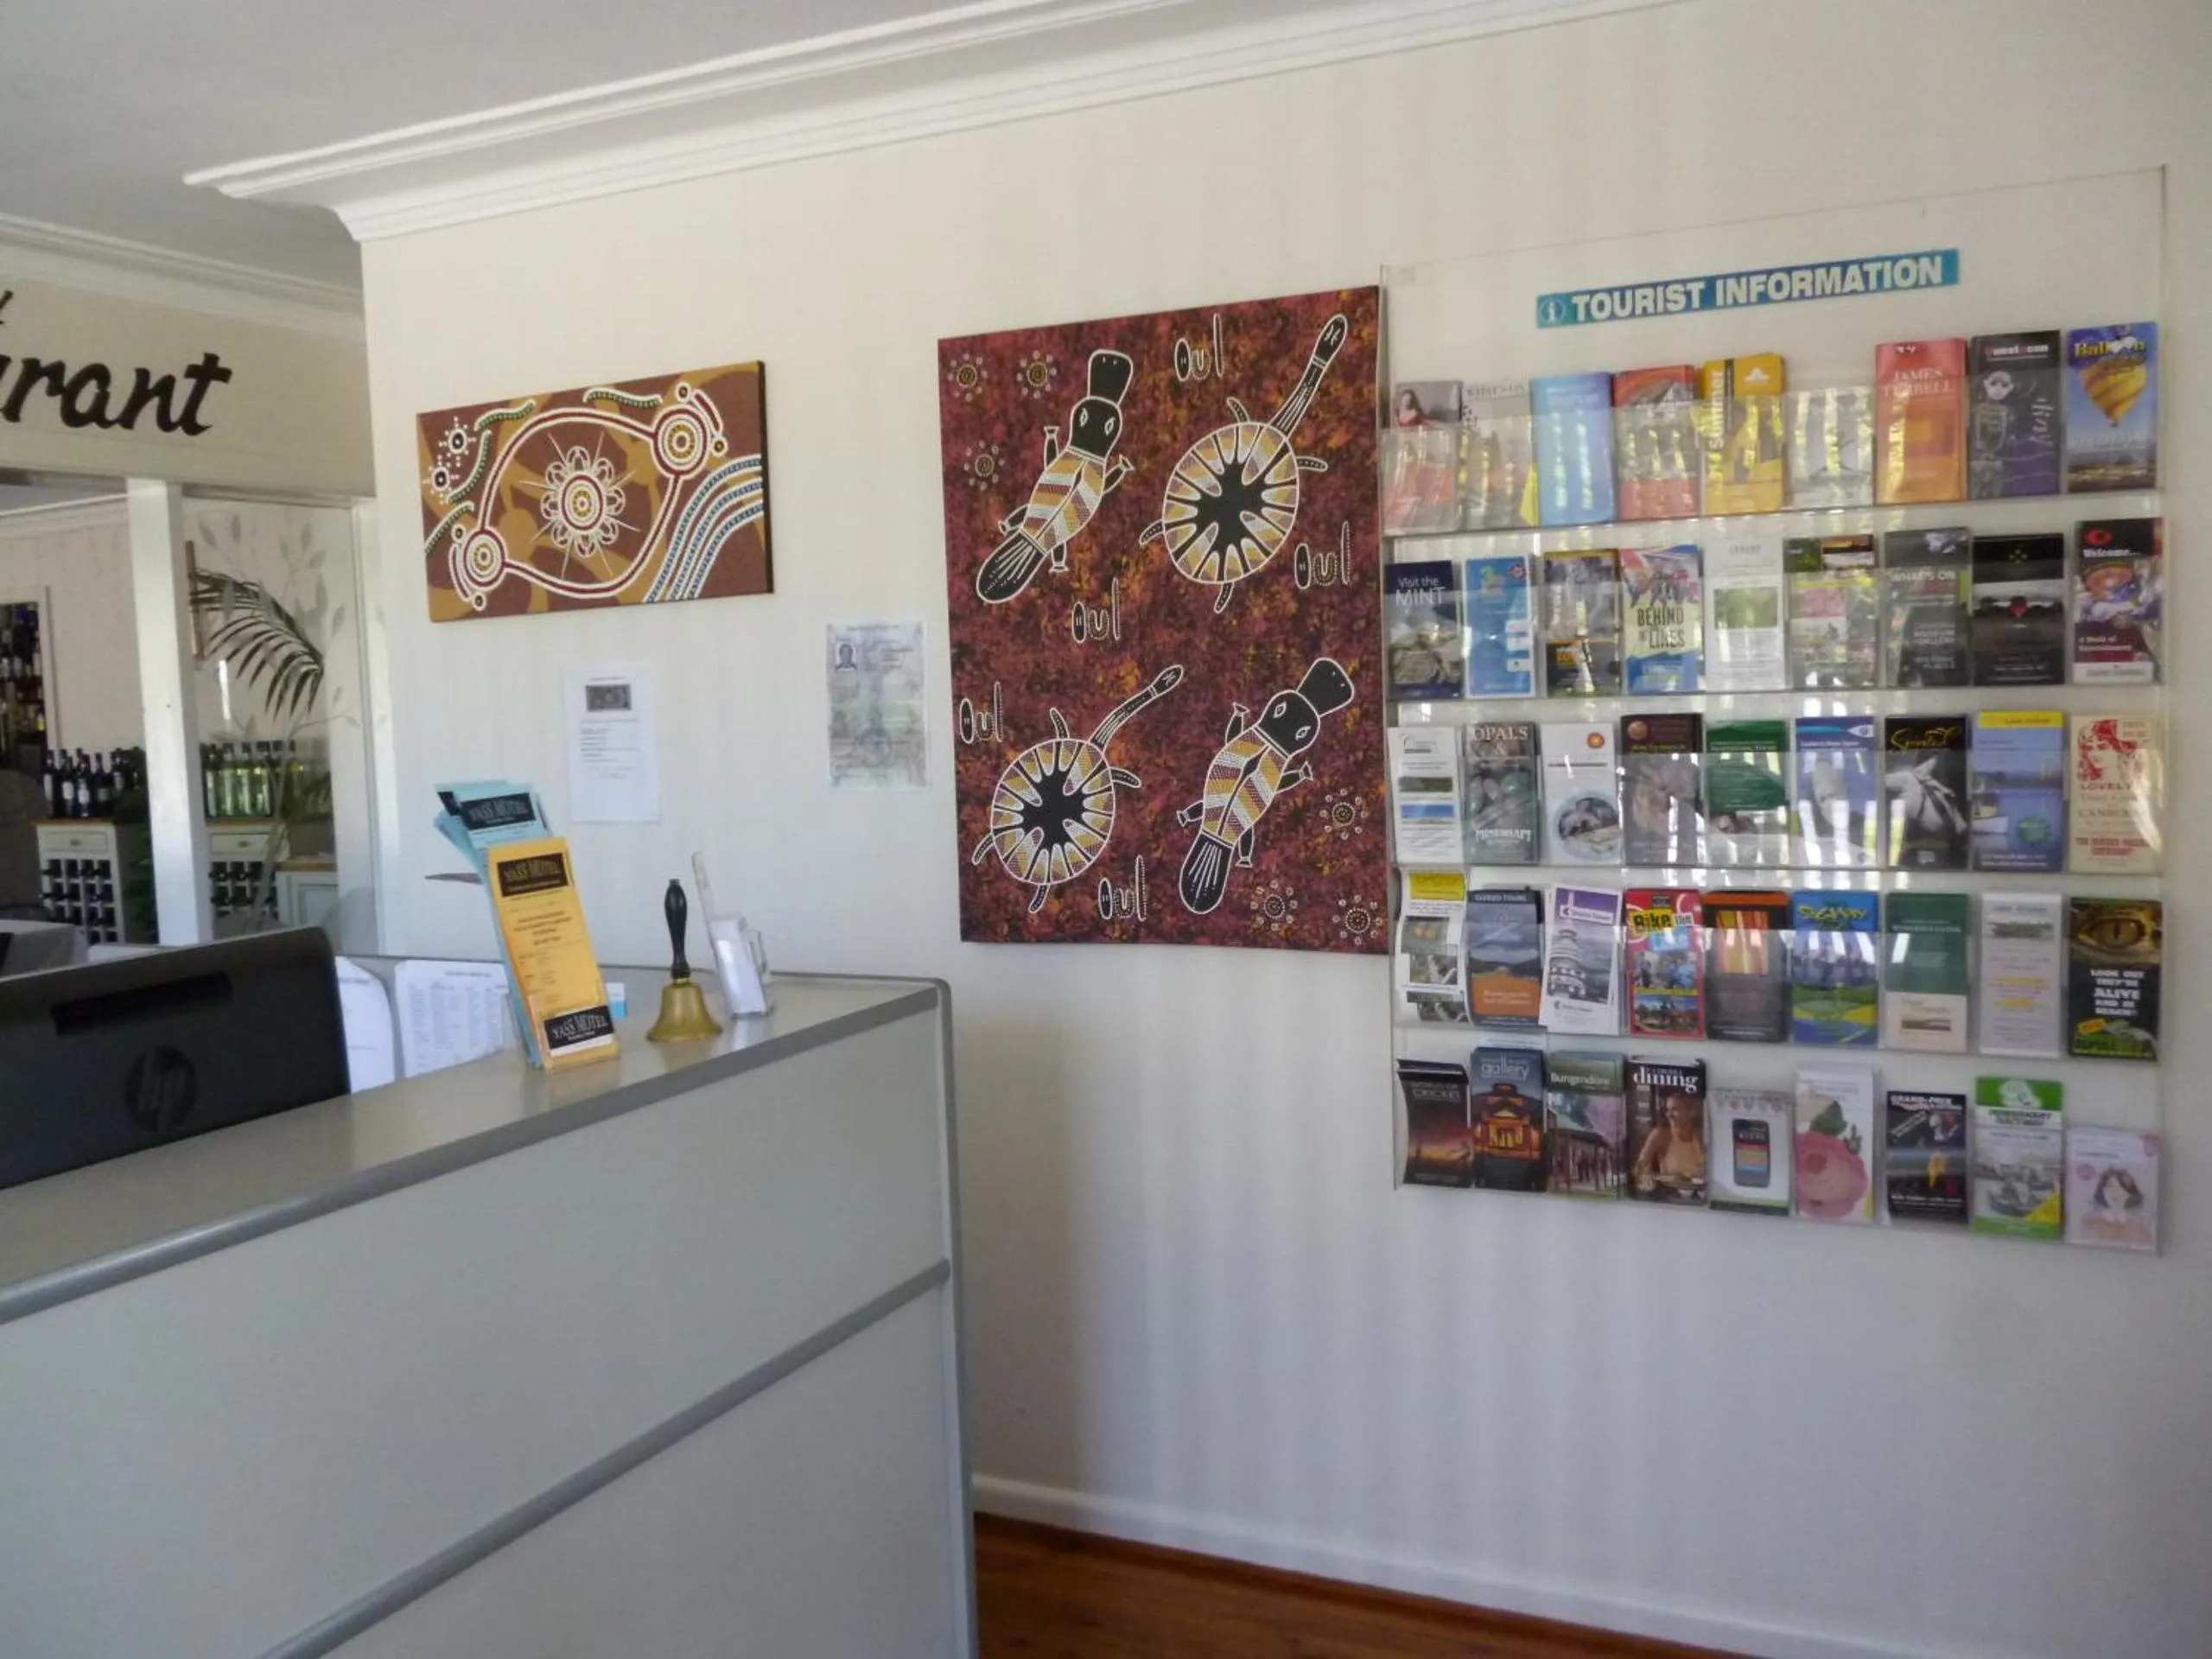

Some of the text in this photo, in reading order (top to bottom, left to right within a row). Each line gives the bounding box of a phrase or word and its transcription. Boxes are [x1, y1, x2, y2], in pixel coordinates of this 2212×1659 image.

[1572, 281, 1705, 321] TOURIST
[1715, 256, 1942, 307] INFORMATION
[1397, 575, 1440, 588] Visit the
[1395, 586, 1446, 606] MINT
[1637, 607, 1685, 627] BEHIND
[1473, 725, 1529, 741] OPALS
[552, 1018, 577, 1039] YASS
[572, 1013, 609, 1033] MOTEL
[1480, 1054, 1530, 1078] gallery
[1632, 1065, 1699, 1094] dining
